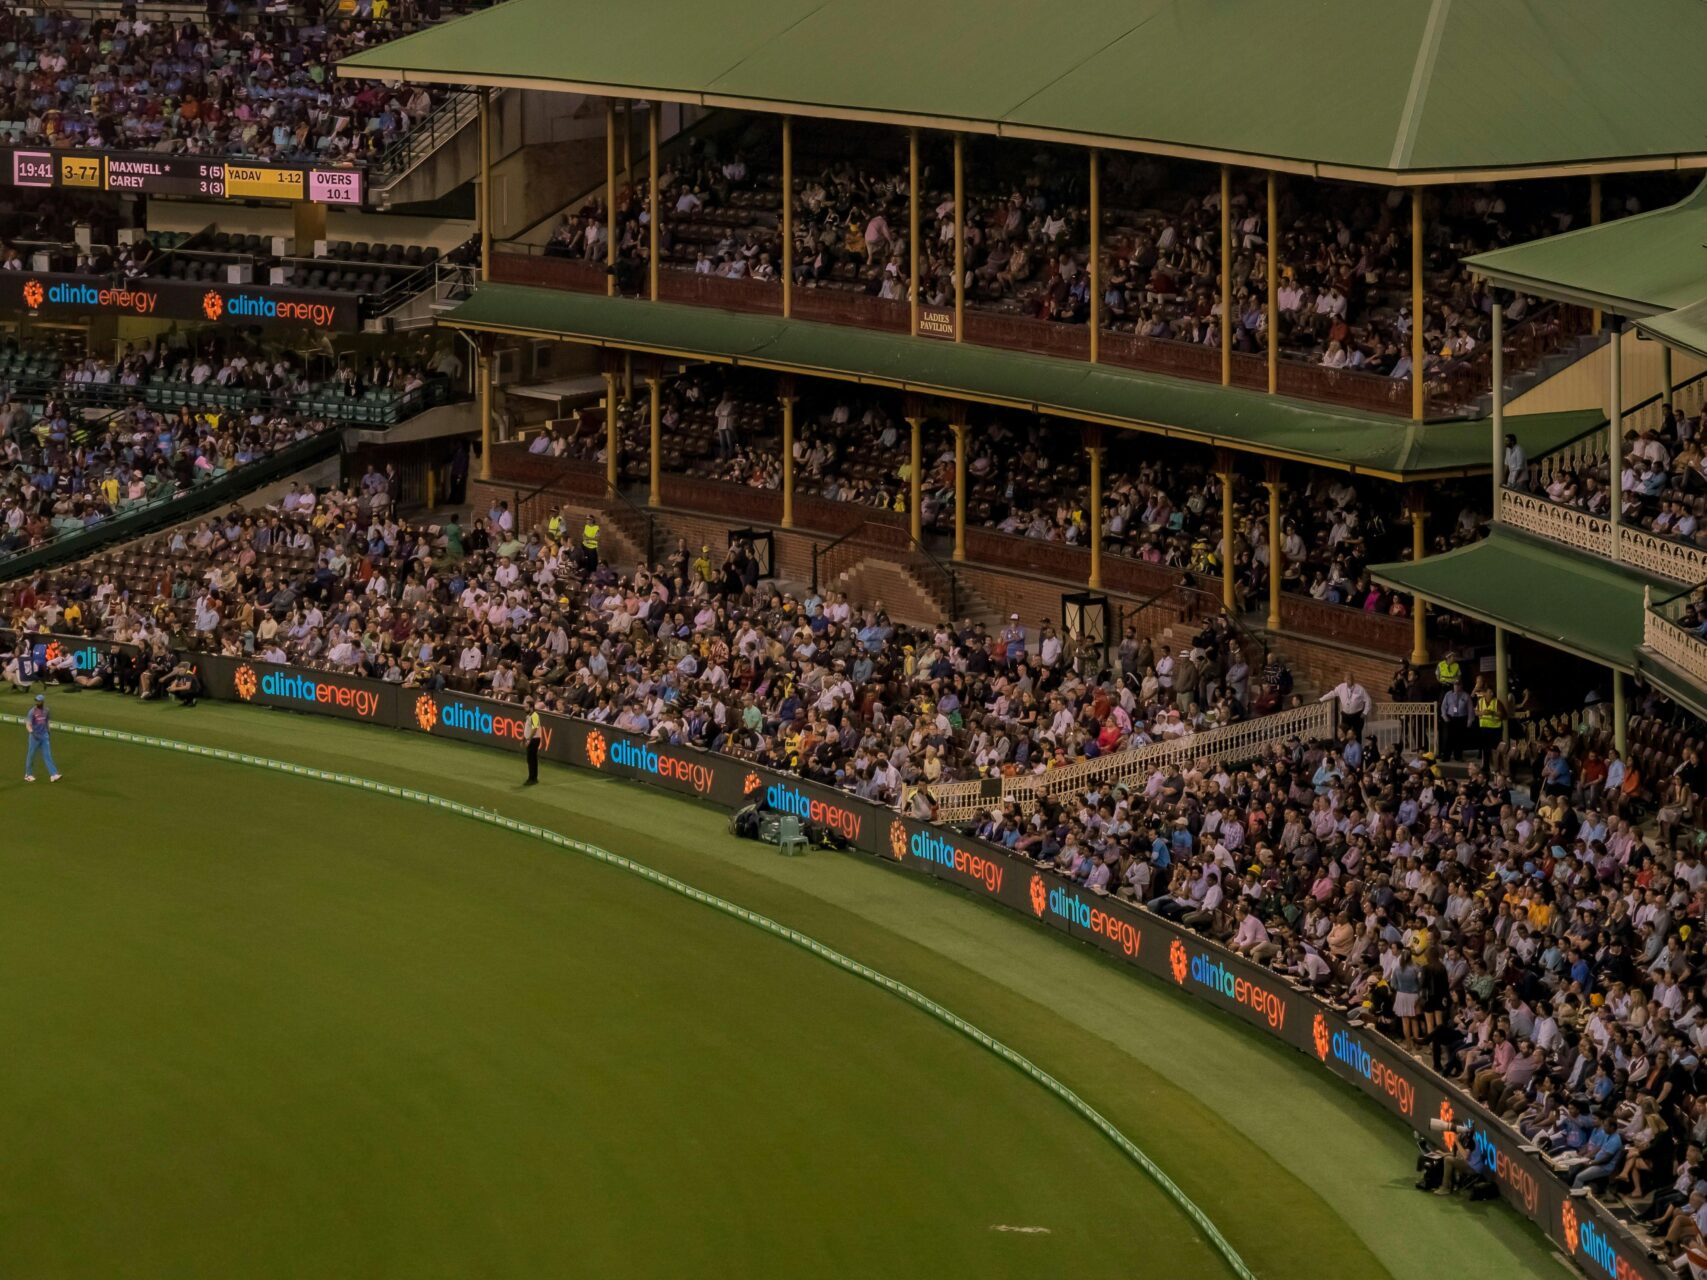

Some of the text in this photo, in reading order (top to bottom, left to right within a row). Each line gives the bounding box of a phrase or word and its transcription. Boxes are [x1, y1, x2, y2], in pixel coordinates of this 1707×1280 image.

[19, 163, 53, 178] 19:41
[64, 165, 98, 181] 3-77
[109, 161, 224, 179] MAXWELL 5 (5)
[229, 169, 301, 183] YADAV 1-12
[109, 175, 224, 195] CAREY 3 (3)
[317, 174, 352, 185] OVERS
[327, 189, 351, 200] 10.1
[924, 312, 950, 323] LADIES
[920, 321, 953, 333] PAVILION
[442, 702, 552, 752] alintaeney
